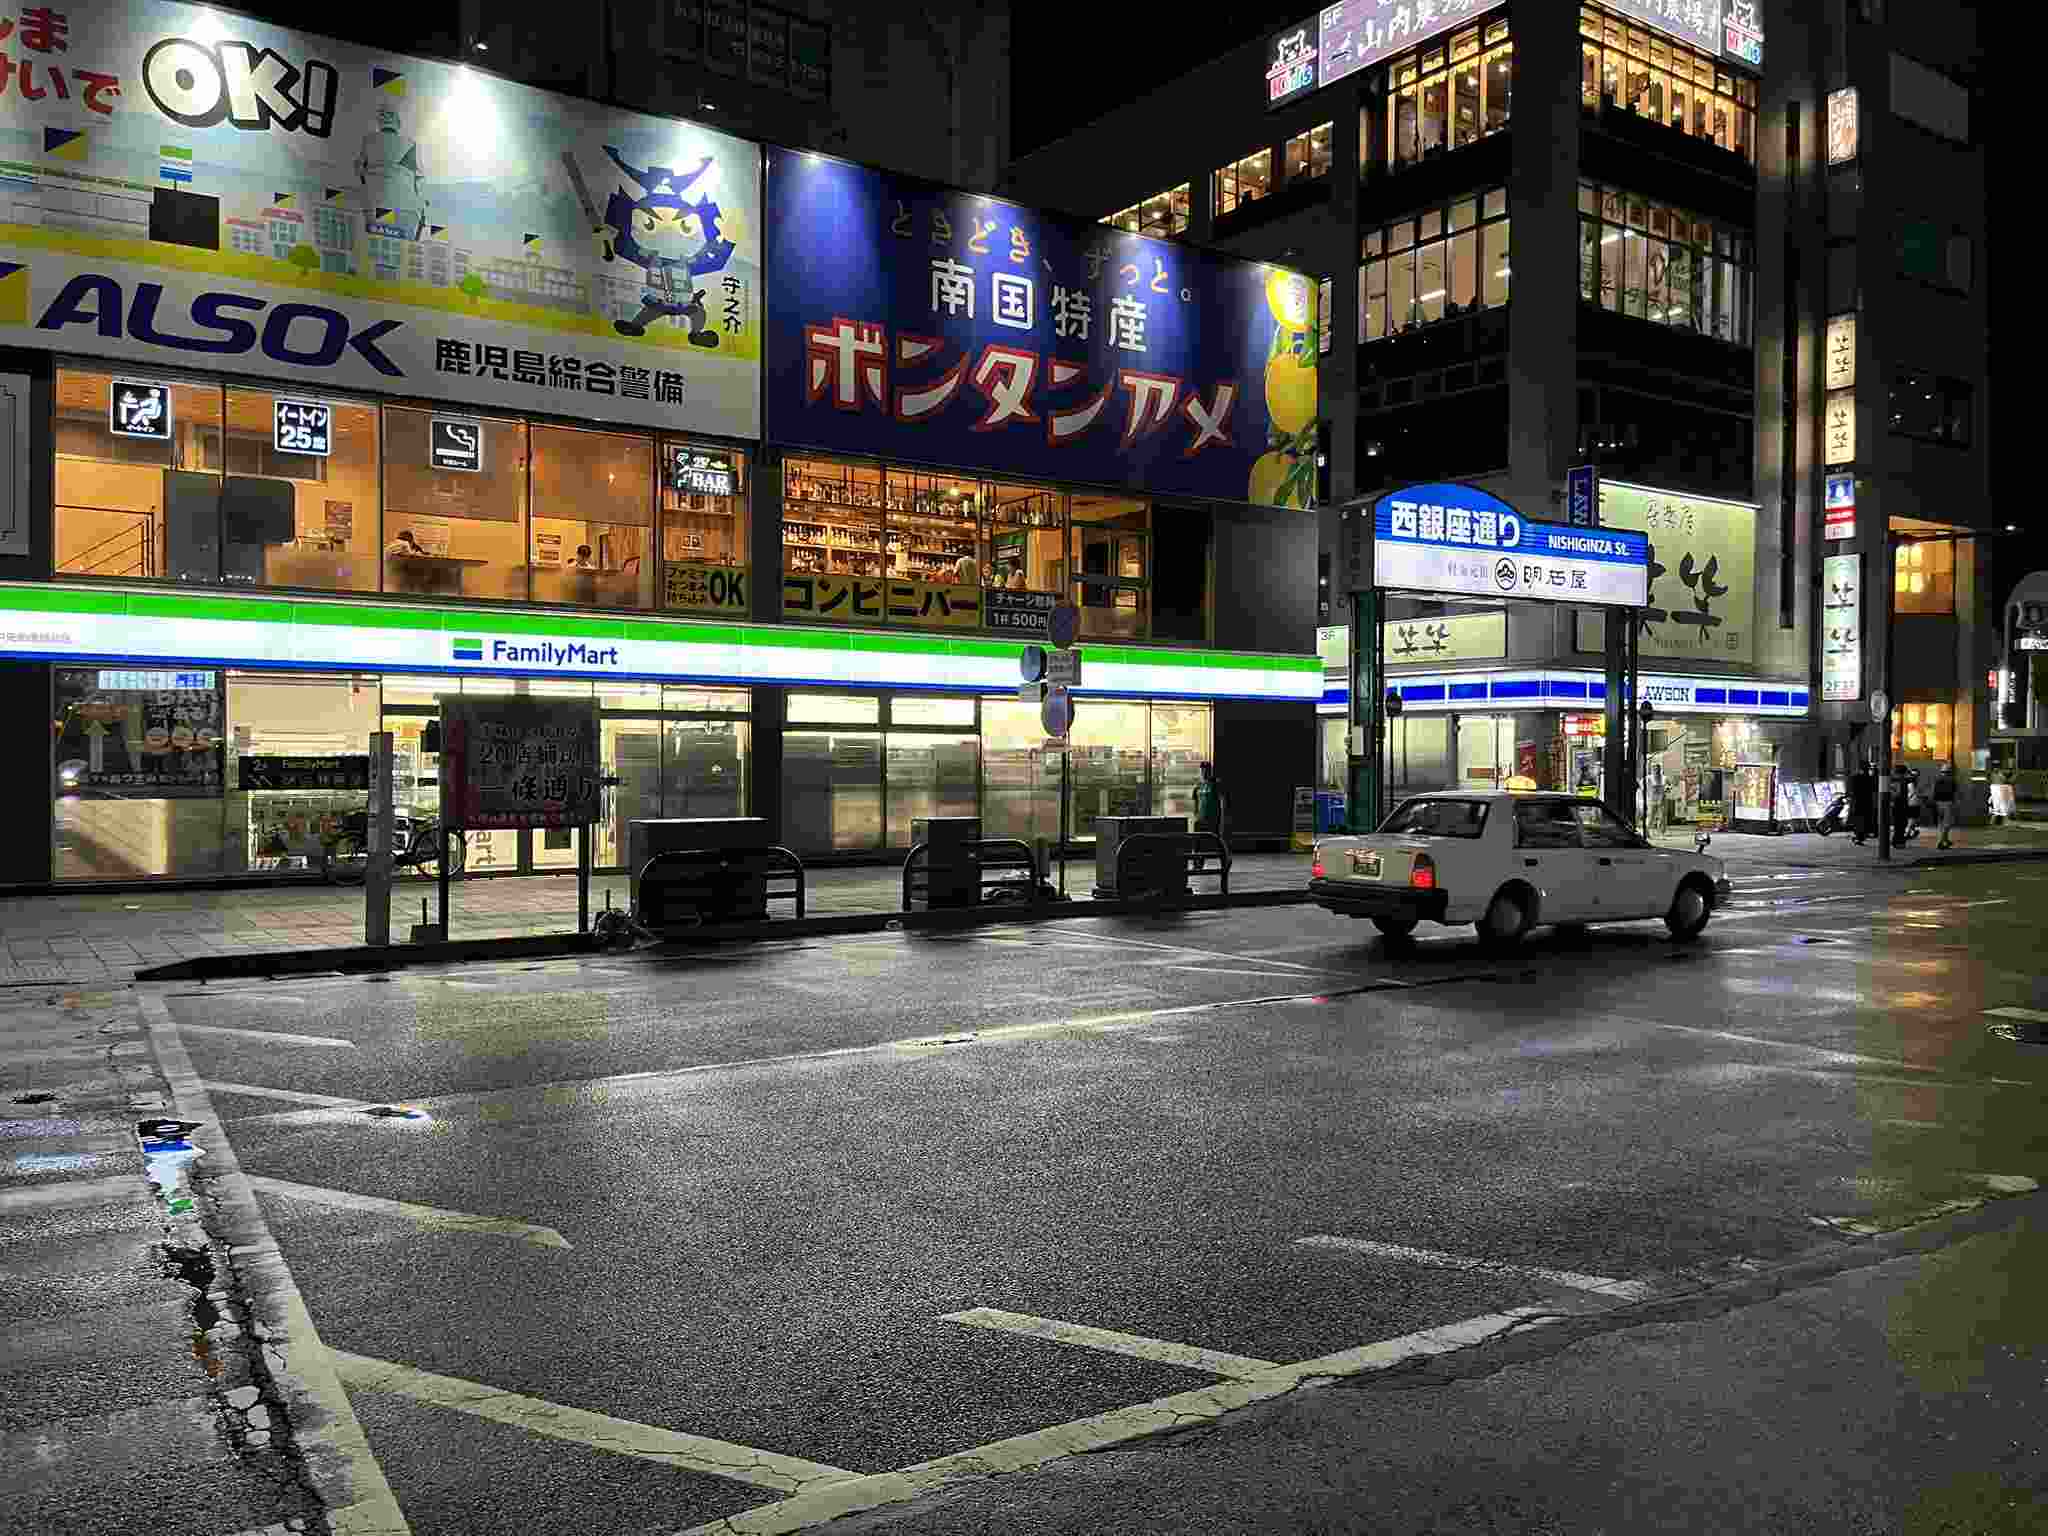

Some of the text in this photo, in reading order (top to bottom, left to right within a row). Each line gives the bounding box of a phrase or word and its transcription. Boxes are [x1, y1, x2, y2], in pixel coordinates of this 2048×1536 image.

[142, 37, 338, 138] OK!
[35, 273, 405, 377] ALSOK
[931, 256, 1149, 352] 南国特産
[435, 337, 686, 406] 鹿児島綜合警備
[807, 315, 1237, 457] ボンタンアメ
[1391, 501, 1520, 548] 西銀座通り
[1548, 534, 1612, 555] NISHIGINZA
[710, 570, 745, 607] OK
[493, 640, 617, 666] FamilyMart
